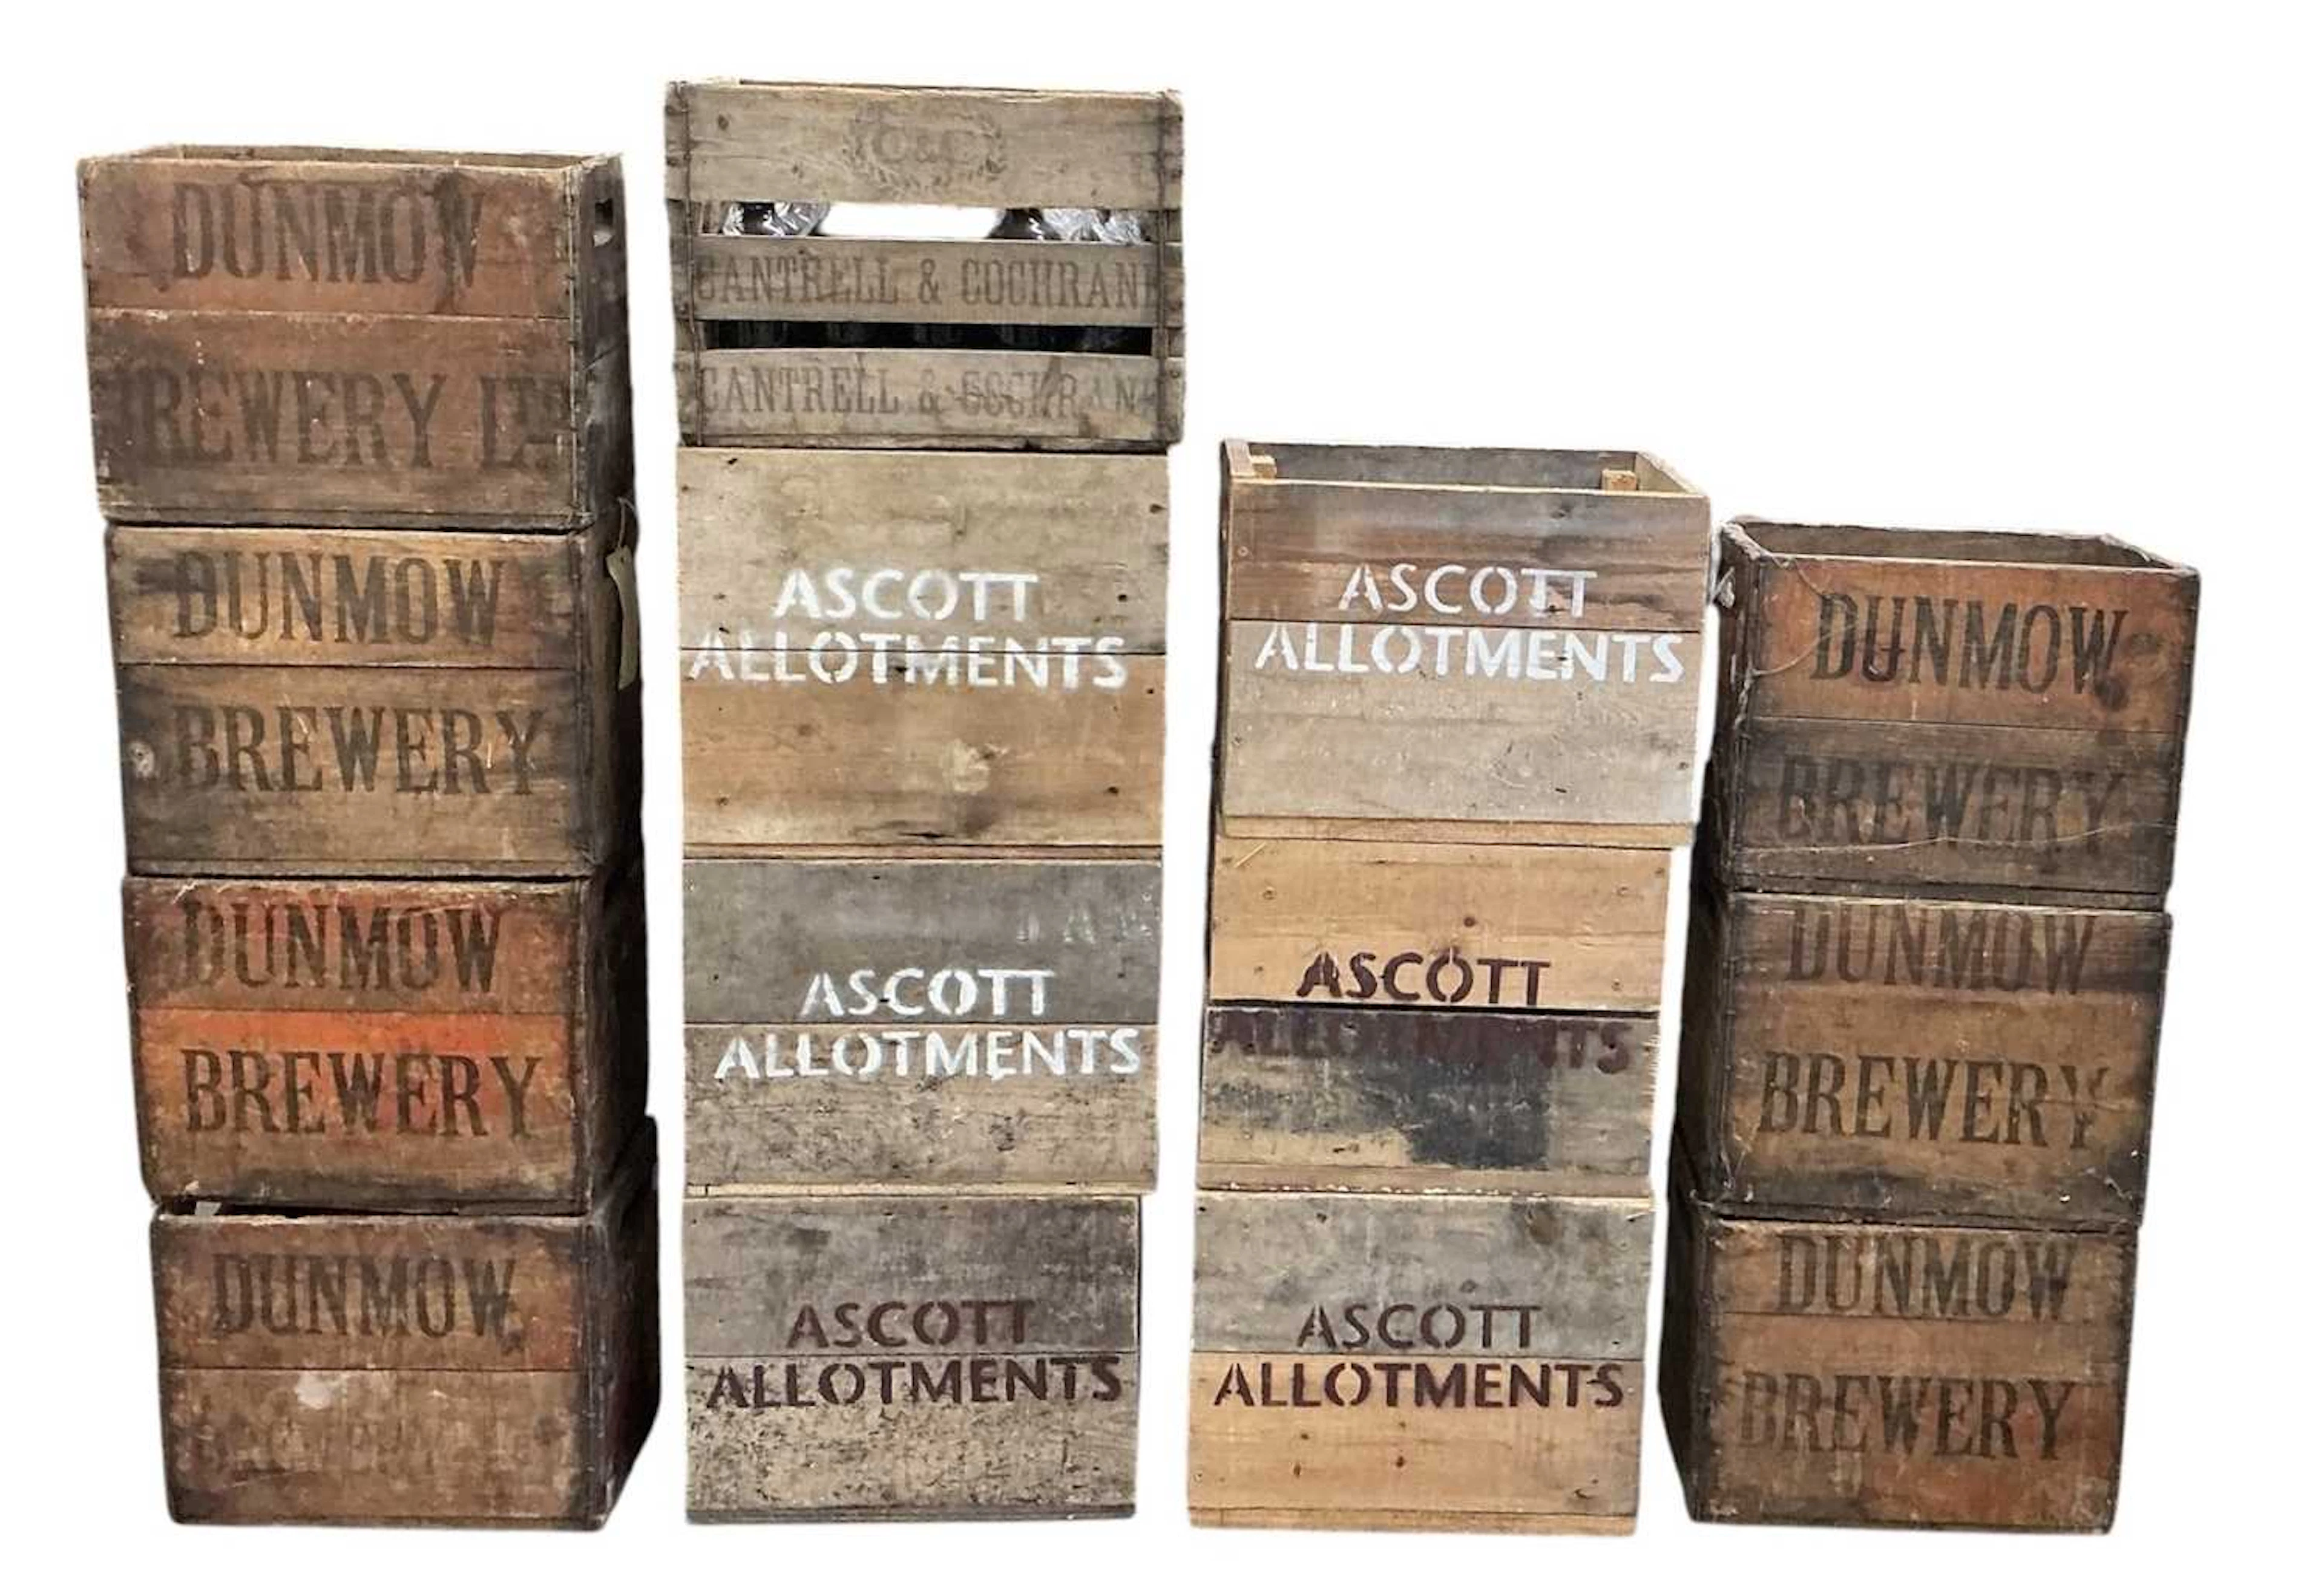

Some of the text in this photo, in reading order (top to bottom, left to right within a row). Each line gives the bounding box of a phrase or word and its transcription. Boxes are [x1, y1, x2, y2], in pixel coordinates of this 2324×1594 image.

[172, 182, 484, 287] DUNMOW
[696, 255, 899, 303] CANTRELL
[917, 258, 942, 305] &
[697, 366, 899, 414] CANTRELL
[919, 369, 942, 415] &
[174, 549, 507, 646] DUNMOW
[774, 568, 1038, 622] ASCOTT
[1339, 564, 1597, 618] ASCOTT
[689, 631, 1128, 689] ALLOTMENTS
[1255, 625, 1684, 683] ALLOTMENTS
[1815, 591, 2132, 695] DUNMOW
[172, 704, 548, 795] BREWERY
[1777, 756, 2127, 851] BREWERY
[180, 899, 502, 994] DUNMOW
[1787, 904, 2098, 996] DUNMOW
[800, 968, 1055, 1016] ASCOTT
[1297, 951, 1550, 1006] ASCOTT
[715, 1029, 1141, 1080] ALLOTMENTS
[180, 1048, 543, 1138] BREWERY
[1758, 1050, 2110, 1148] BREWERY
[213, 1252, 518, 1341] DUNMOW
[1775, 1233, 2084, 1320] DUNMOW
[787, 1300, 1035, 1349] ASCOTT
[1298, 1304, 1543, 1349] ASCOTT
[706, 1355, 1122, 1409] ALLOTMENTS
[1213, 1363, 1624, 1408] ALLOTMENTS
[1736, 1369, 2078, 1460] BREWERY
